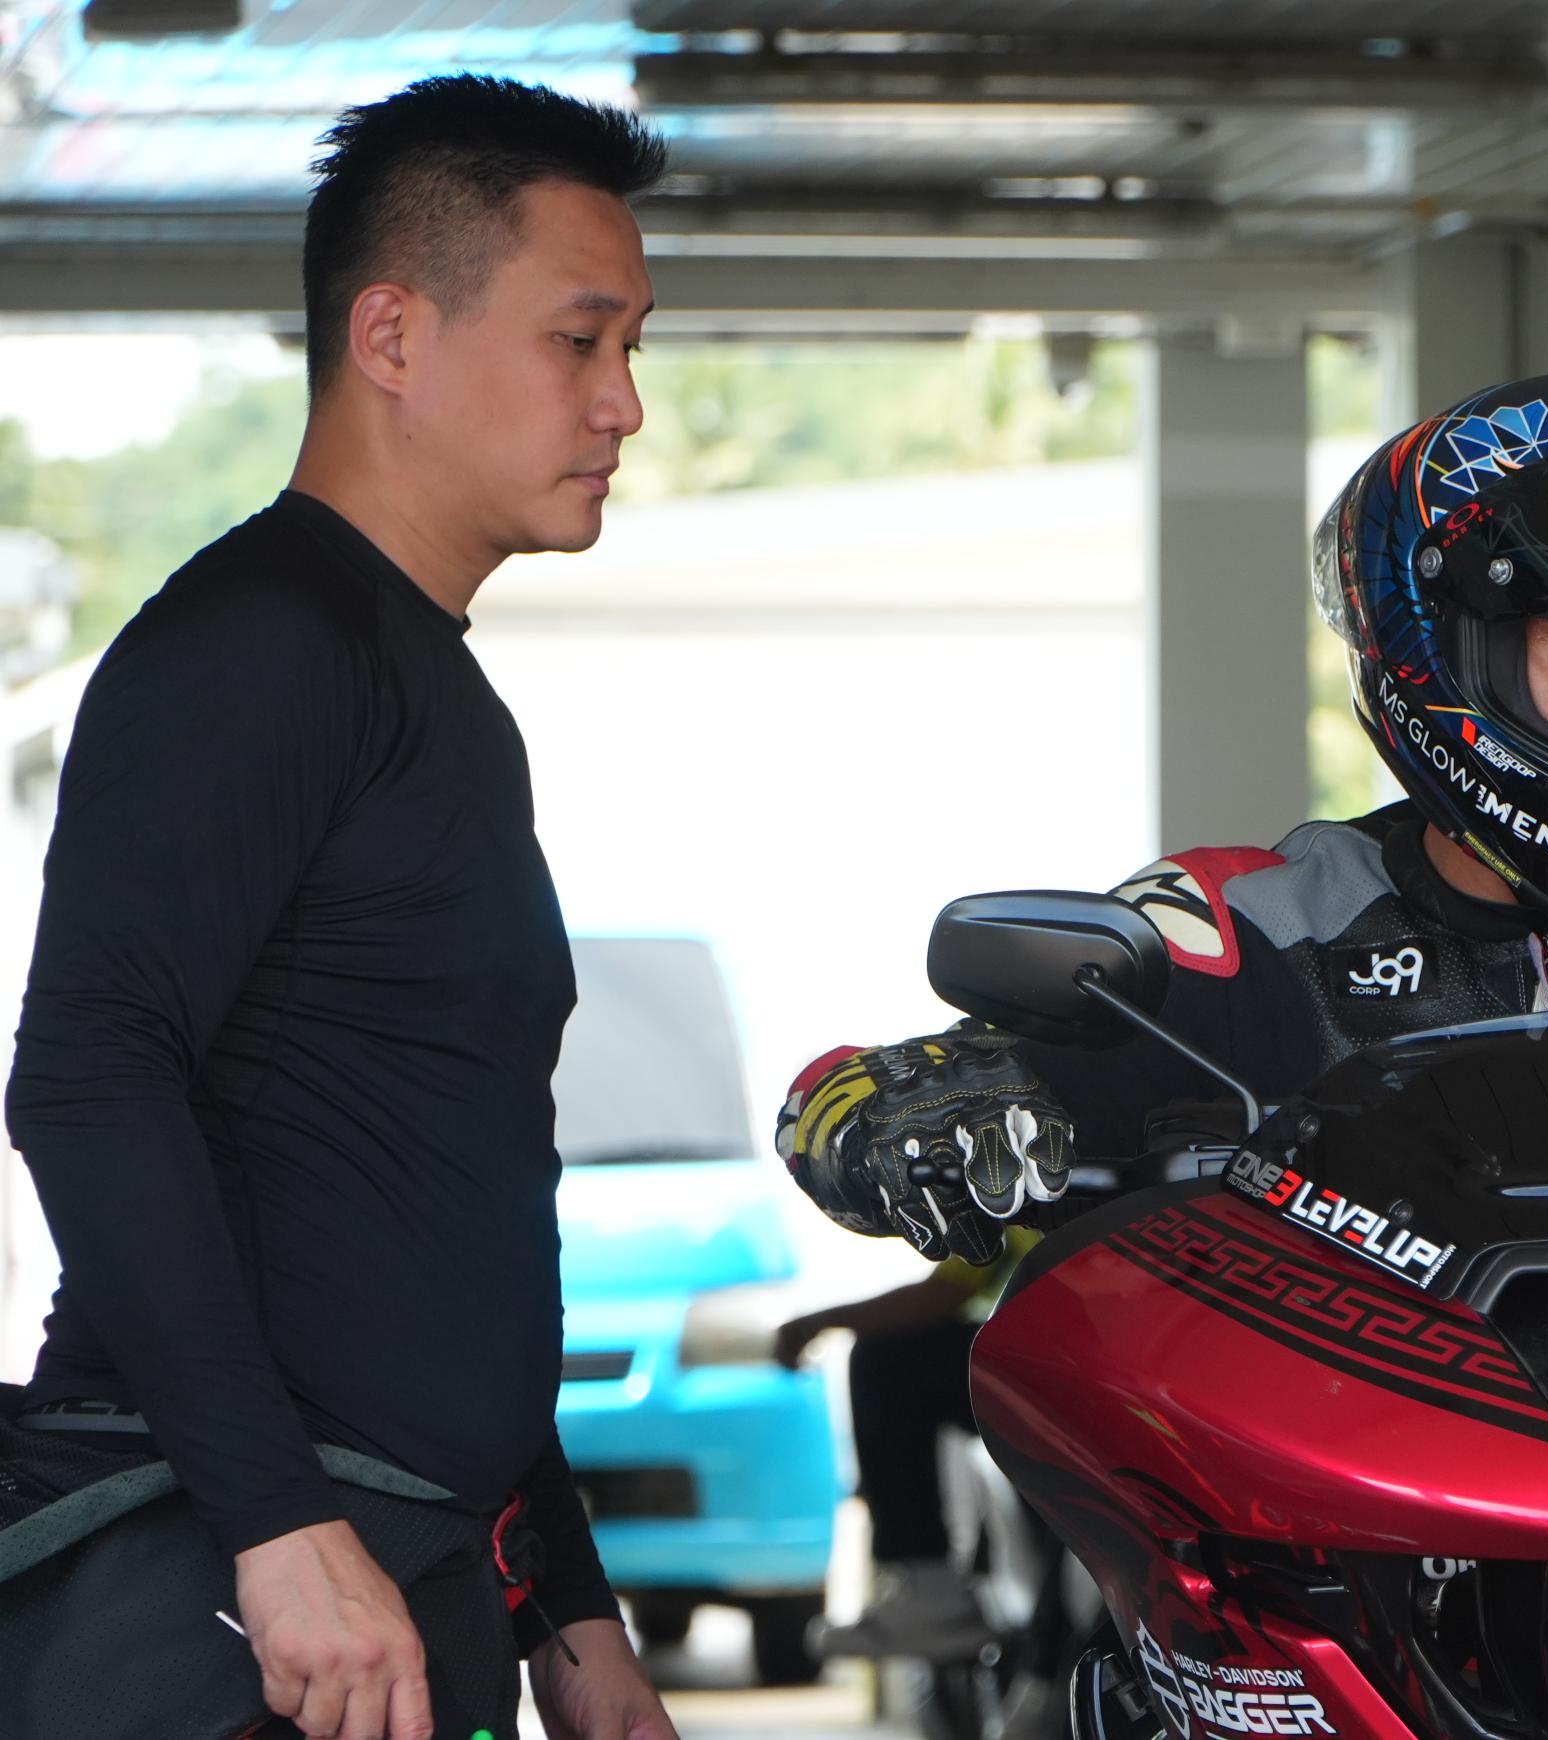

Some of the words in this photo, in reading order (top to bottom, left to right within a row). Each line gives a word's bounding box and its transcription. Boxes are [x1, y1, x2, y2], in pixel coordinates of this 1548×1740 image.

[1379, 672, 1408, 724] MS
[1408, 717, 1476, 792] GLOW
[1473, 742, 1510, 773] DESIGN
[1464, 831, 1496, 861] EMERGENCY
[1494, 859, 1507, 872] USE
[1505, 868, 1521, 882] ONLY
[1348, 985, 1381, 996] CORP
[1226, 1173, 1267, 1200] MOTOSHOP
[1418, 1243, 1457, 1291] MOTORSPORT
[1182, 1676, 1337, 1735] BAGGER
